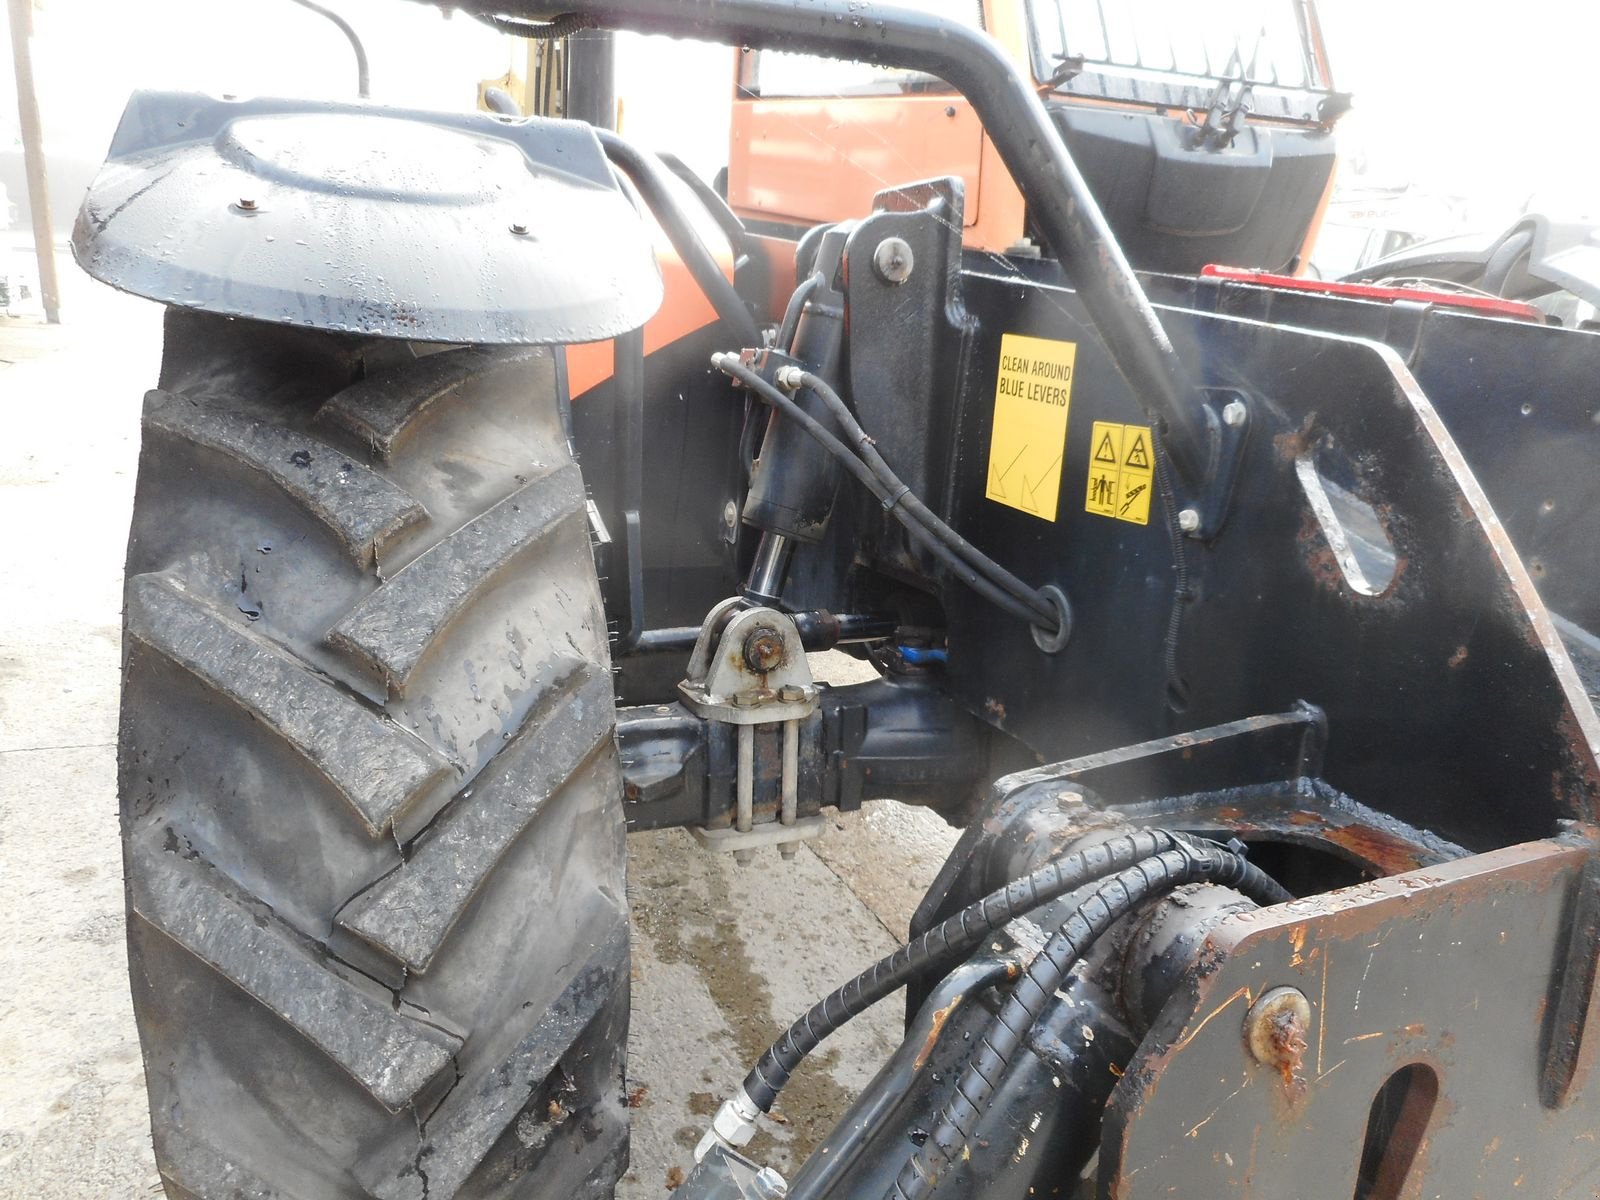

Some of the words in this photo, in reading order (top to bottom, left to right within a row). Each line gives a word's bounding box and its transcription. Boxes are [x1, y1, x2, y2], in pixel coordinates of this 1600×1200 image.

[1002, 355, 1029, 374] CLEAN
[1031, 360, 1071, 381] AROUND
[1000, 377, 1024, 398] BLUE
[1027, 382, 1067, 407] LEVERS
